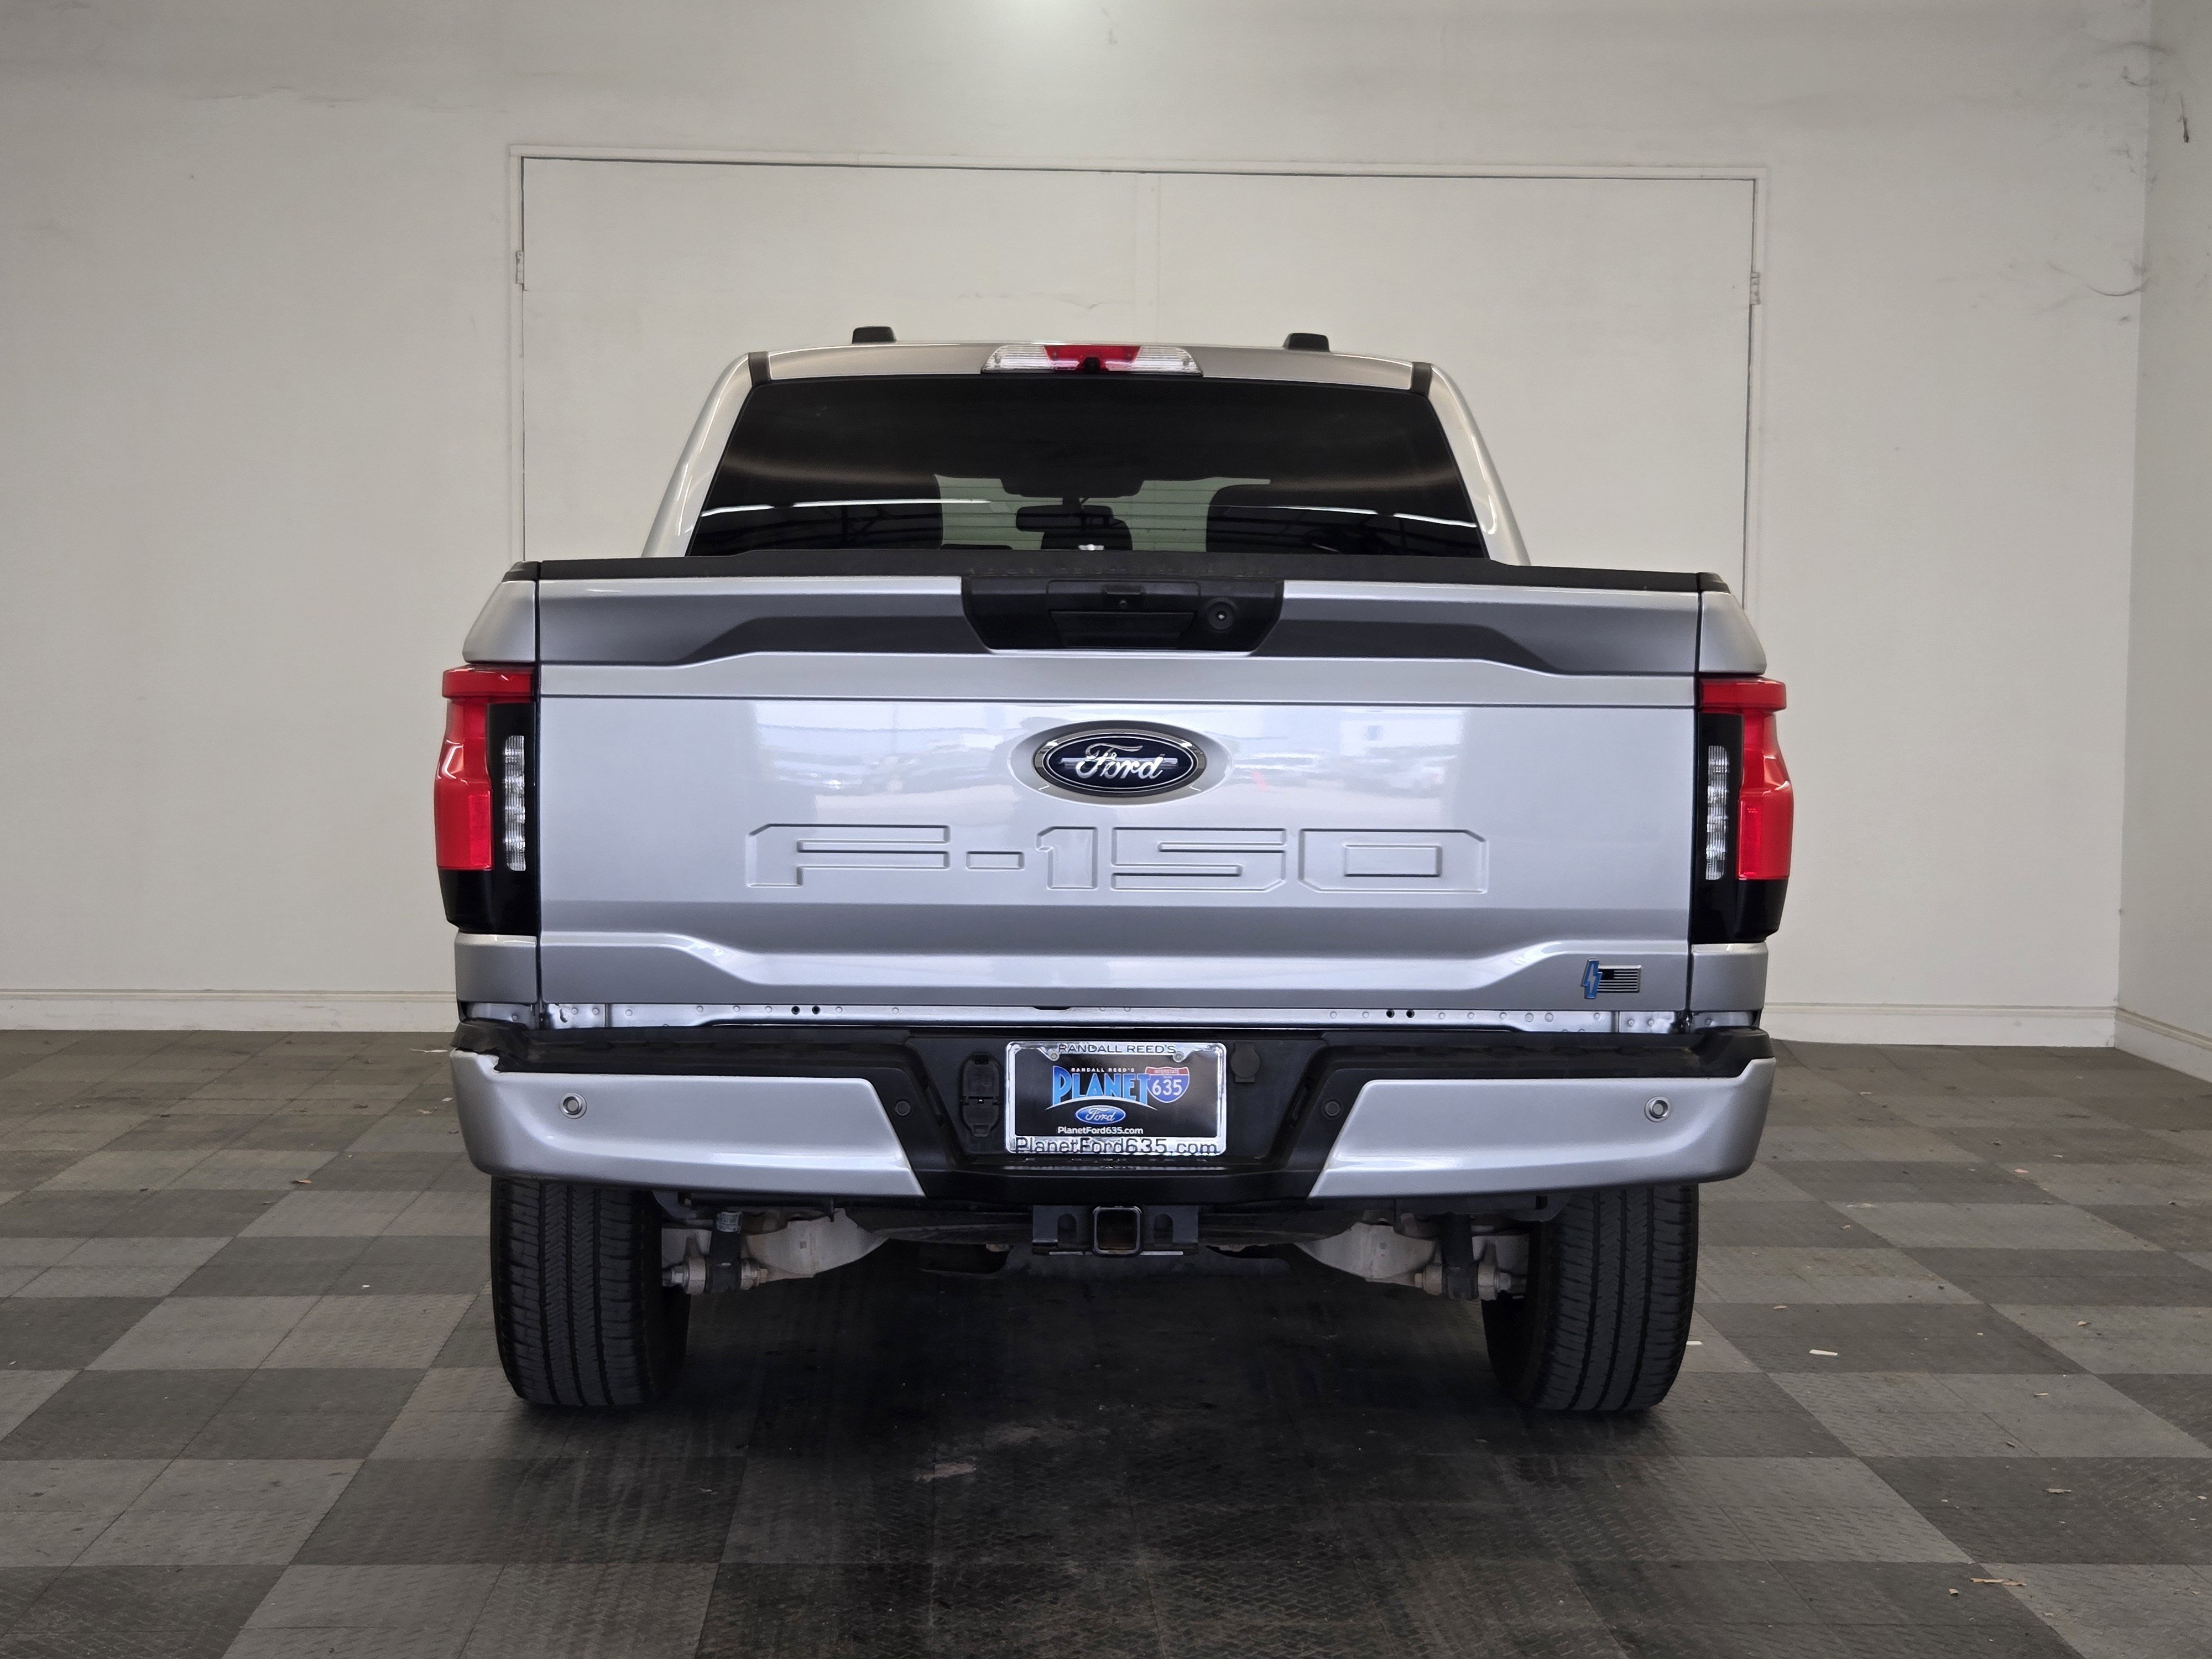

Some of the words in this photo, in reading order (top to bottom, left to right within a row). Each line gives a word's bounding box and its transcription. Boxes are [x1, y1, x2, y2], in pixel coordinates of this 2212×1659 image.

[1076, 743, 1165, 779] Ford
[745, 823, 1488, 893] F-150
[1058, 1044, 1122, 1052] RANDALL
[1126, 1045, 1176, 1053] REED'S
[1052, 1065, 1151, 1105] PLANET
[1152, 1079, 1182, 1095] 635
[1085, 1108, 1117, 1121] Ford
[1057, 1126, 1144, 1134] PlanetFord635.com
[1014, 1136, 1218, 1154] PlanetFord635.com
